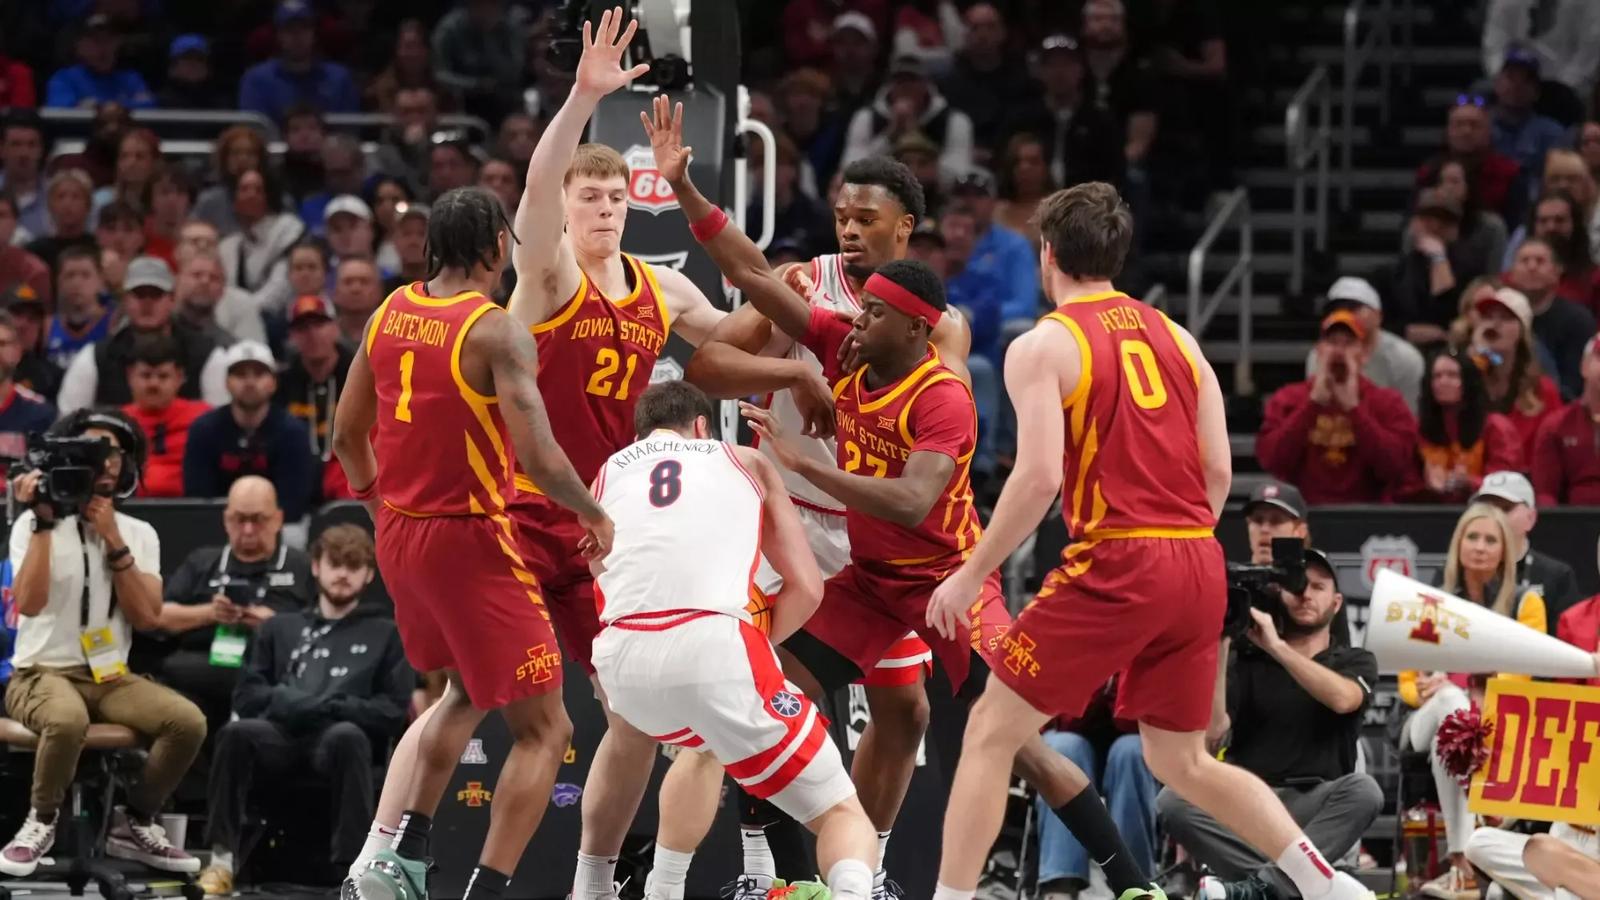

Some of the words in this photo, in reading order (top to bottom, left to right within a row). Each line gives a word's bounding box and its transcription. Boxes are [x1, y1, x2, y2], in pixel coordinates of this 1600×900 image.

[634, 172, 673, 199] 66
[383, 310, 450, 348] BATEMON
[571, 318, 614, 340] IOWA
[620, 320, 664, 356] STATE
[395, 350, 415, 423] 1
[586, 348, 637, 400] 21
[1121, 339, 1167, 409] 0
[613, 440, 719, 469] KHARCHENKOV
[836, 408, 856, 436] OWA
[860, 426, 912, 462] STATE
[845, 441, 887, 478] 27
[649, 459, 683, 509] 8
[1386, 602, 1471, 640] STATE
[516, 652, 560, 680] STATE
[1002, 636, 1041, 678] STATE
[1481, 694, 1600, 809] DEF
